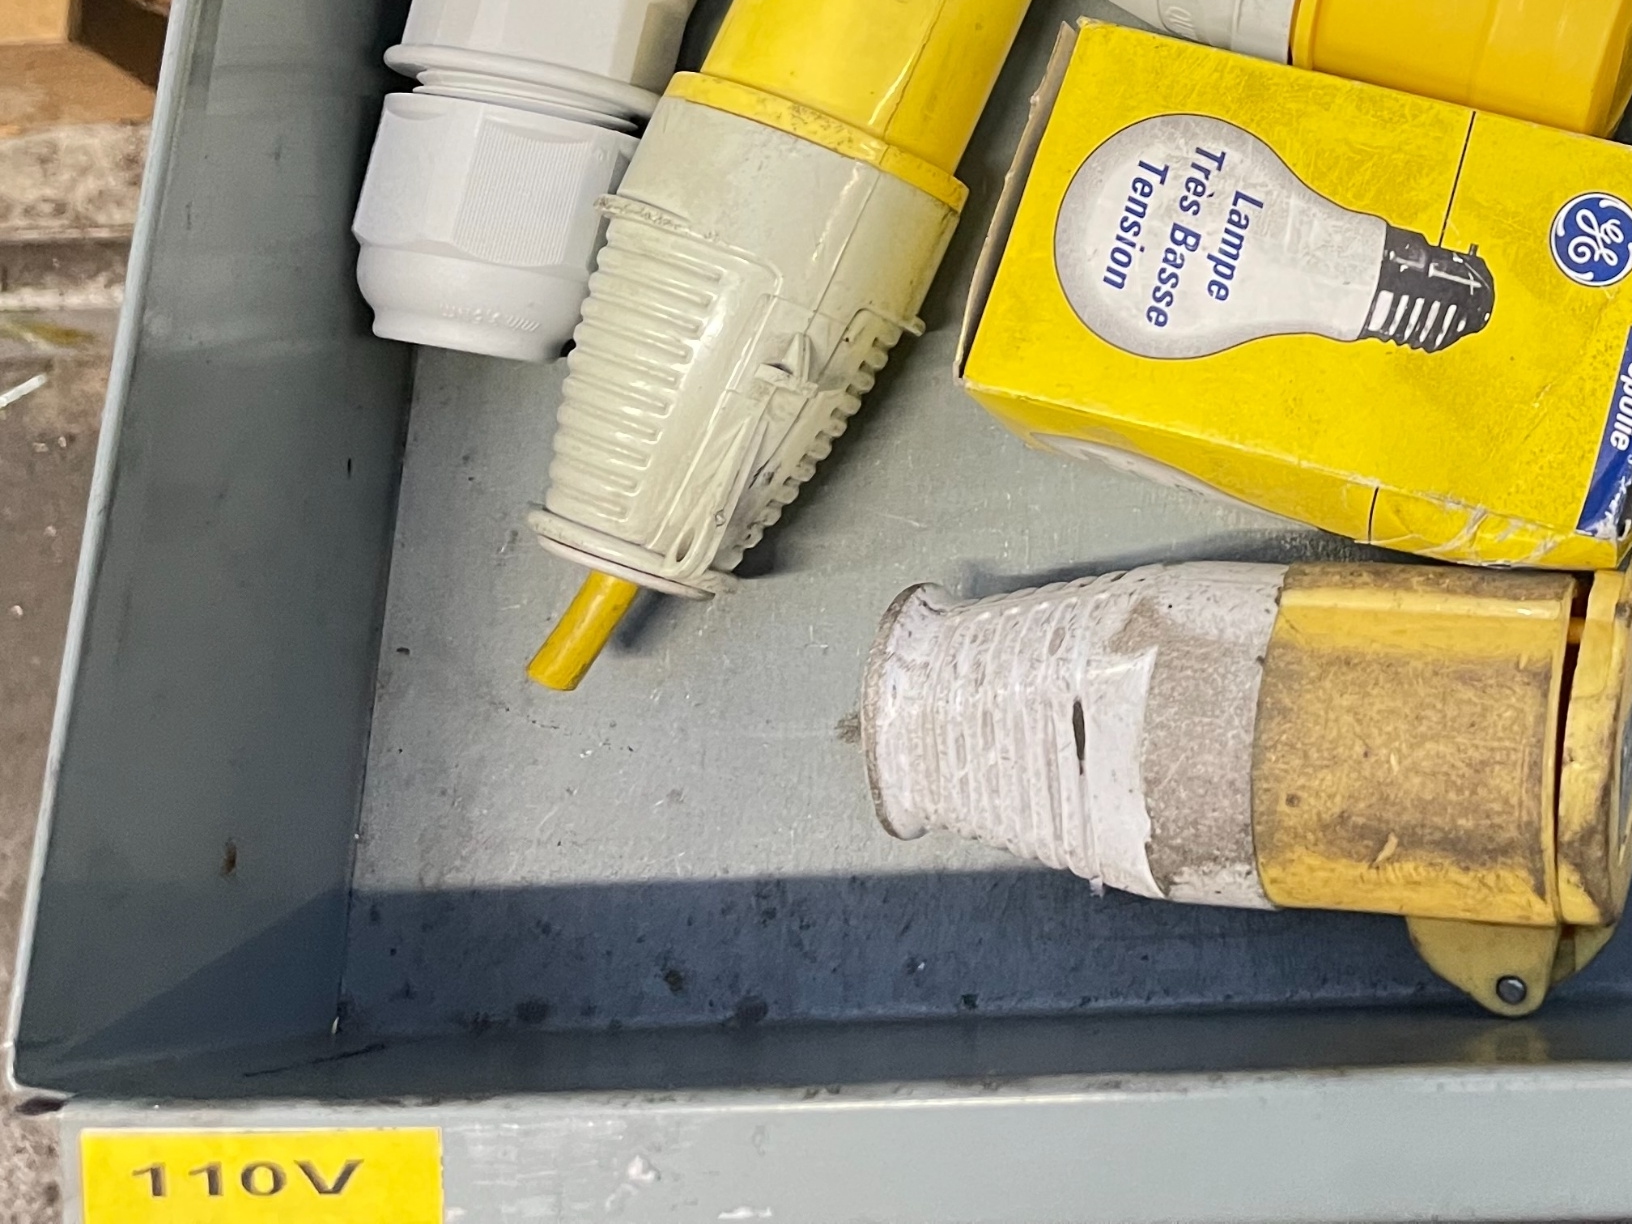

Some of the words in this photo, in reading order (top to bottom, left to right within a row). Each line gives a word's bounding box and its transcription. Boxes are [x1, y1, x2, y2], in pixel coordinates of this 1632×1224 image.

[1102, 160, 1169, 290] Tension
[1178, 146, 1226, 216] Très
[1146, 222, 1202, 327] Basse
[1206, 190, 1264, 302] Lampe
[131, 1158, 365, 1197] 110V
